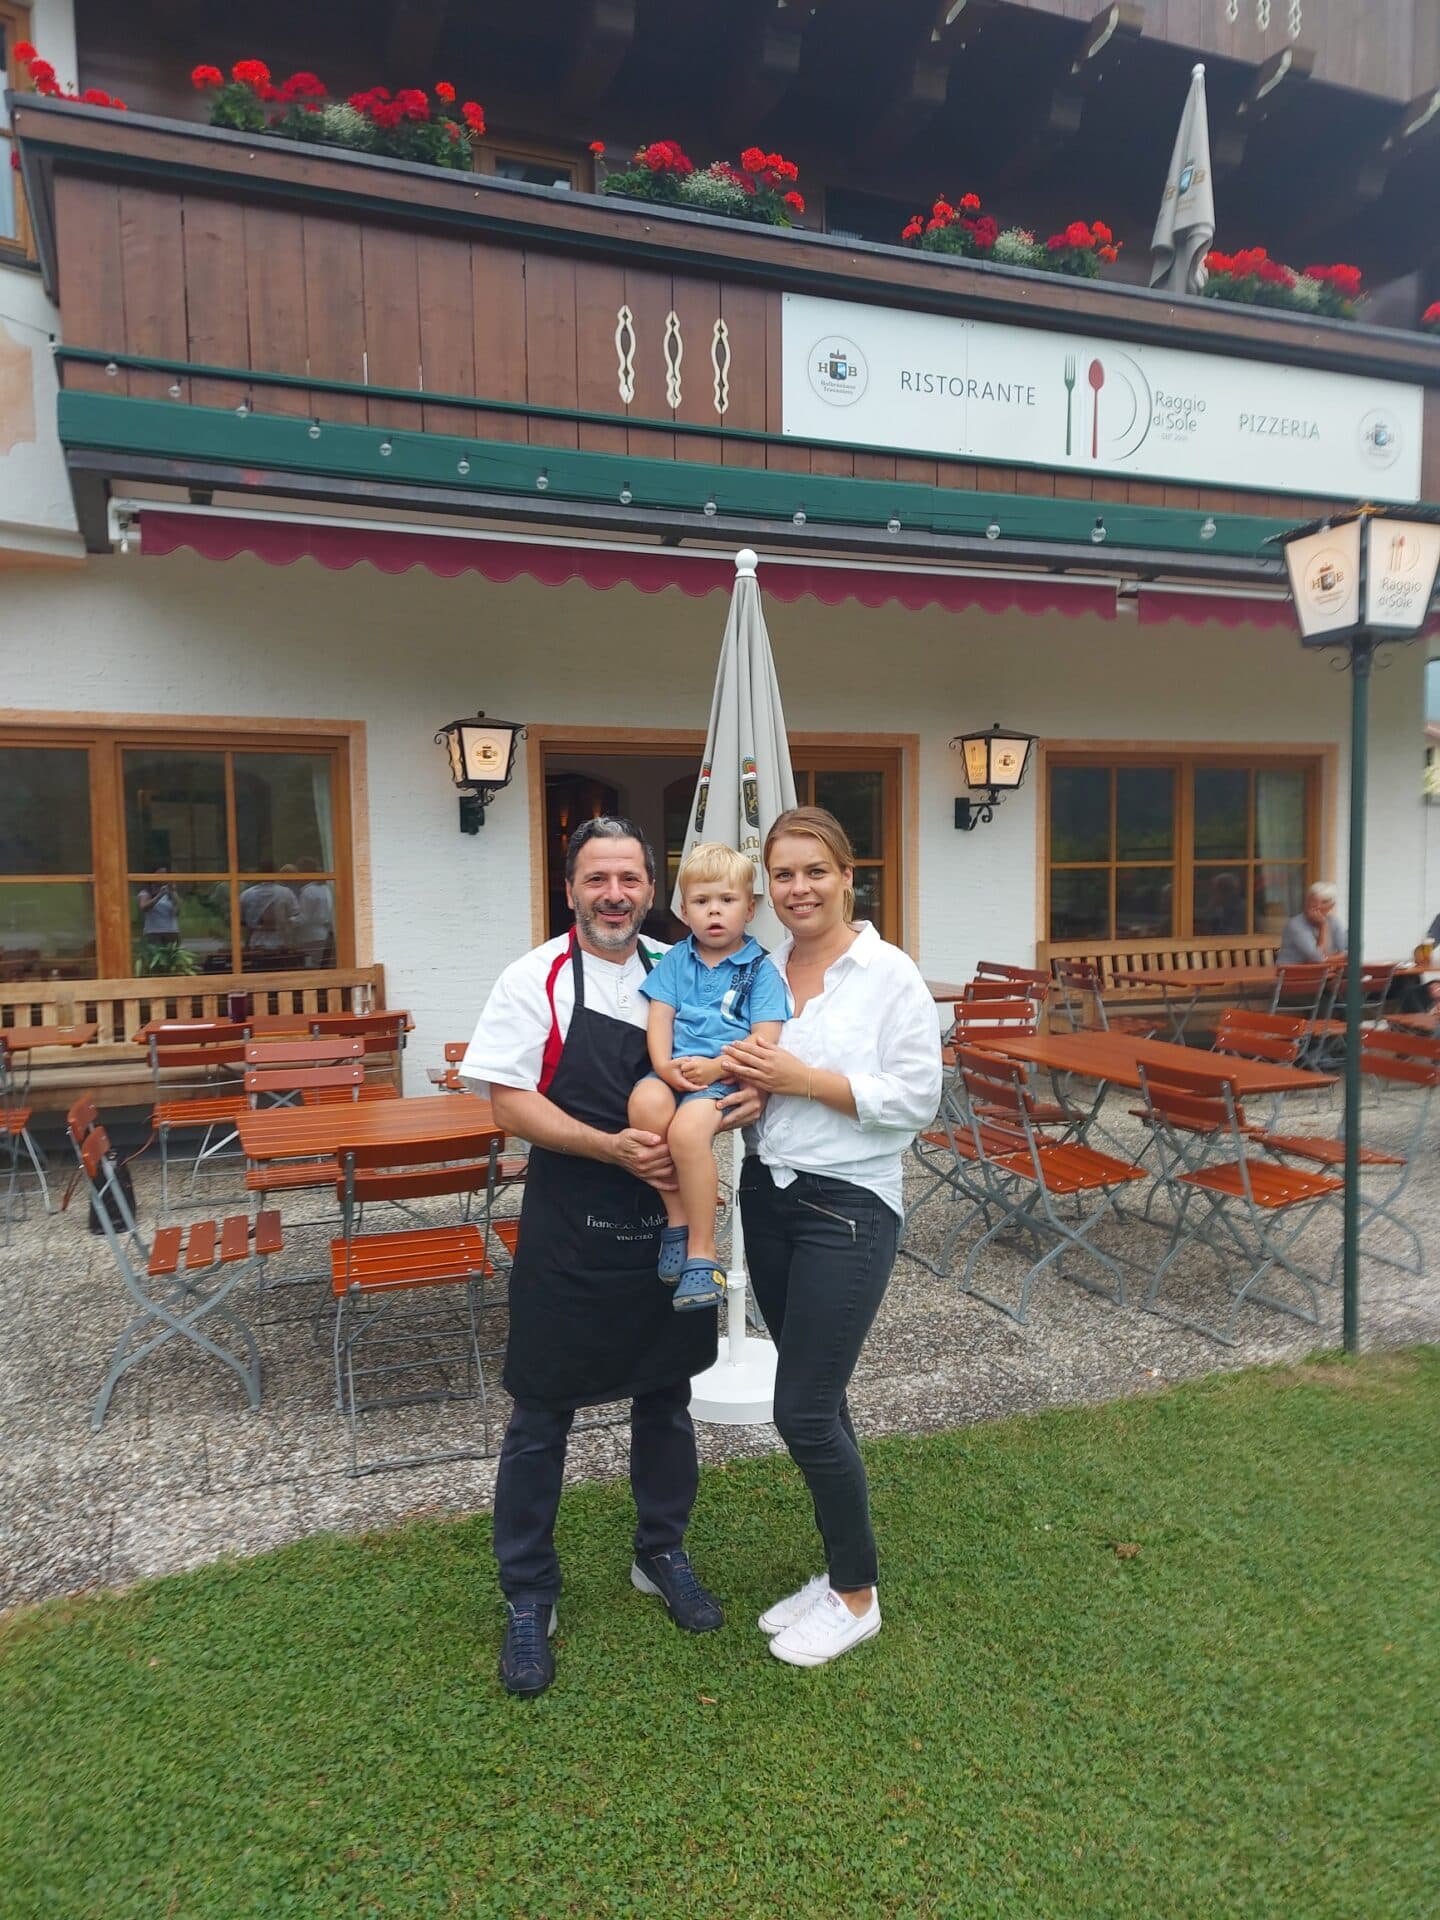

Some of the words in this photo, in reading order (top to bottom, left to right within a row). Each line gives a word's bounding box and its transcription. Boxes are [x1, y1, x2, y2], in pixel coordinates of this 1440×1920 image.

[818, 362, 828, 373] H
[848, 366, 857, 377] B
[901, 370, 1036, 406] RISTORANTE
[1155, 390, 1206, 416] Raggio
[1167, 413, 1197, 431] Sole
[1239, 413, 1320, 440] PIZZERIA
[1382, 576, 1422, 595] Raggio
